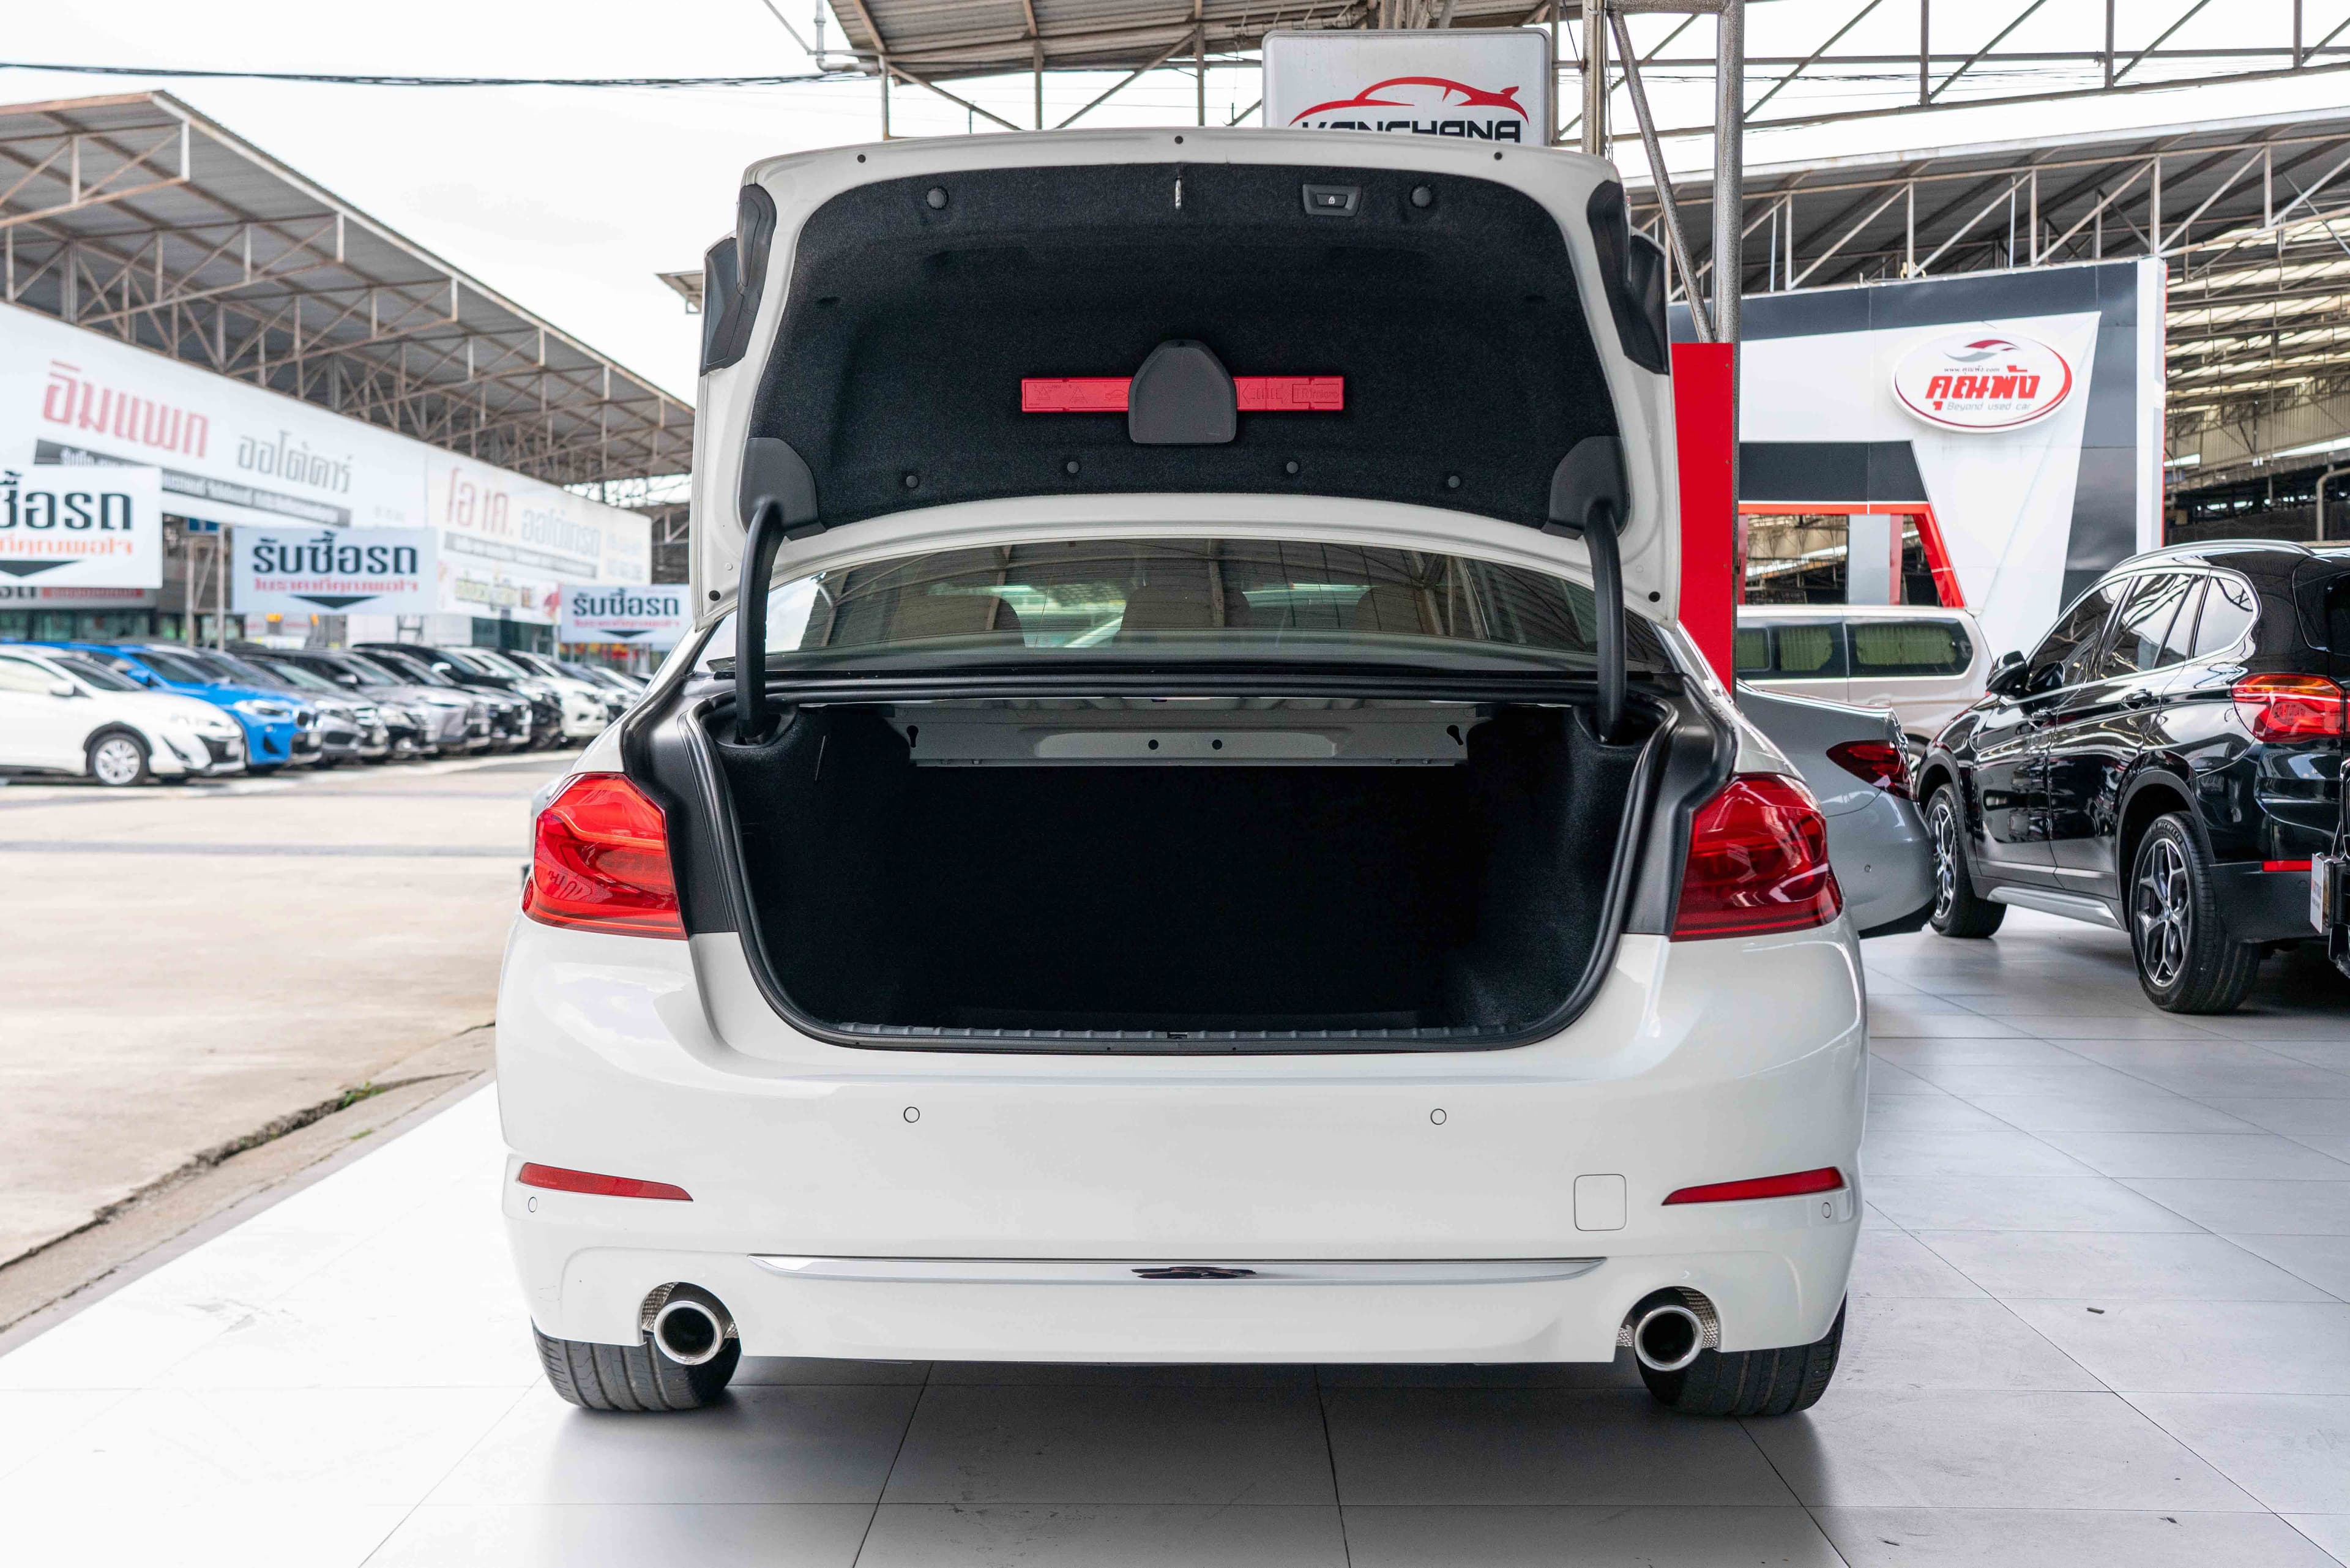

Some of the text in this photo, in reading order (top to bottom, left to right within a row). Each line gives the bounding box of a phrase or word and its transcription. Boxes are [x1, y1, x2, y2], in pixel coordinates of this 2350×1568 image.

[1302, 120, 1521, 143] HANA
[1947, 401, 1983, 411] Beyond
[1988, 401, 2012, 410] used
[253, 530, 417, 574] รับซื้อรถ
